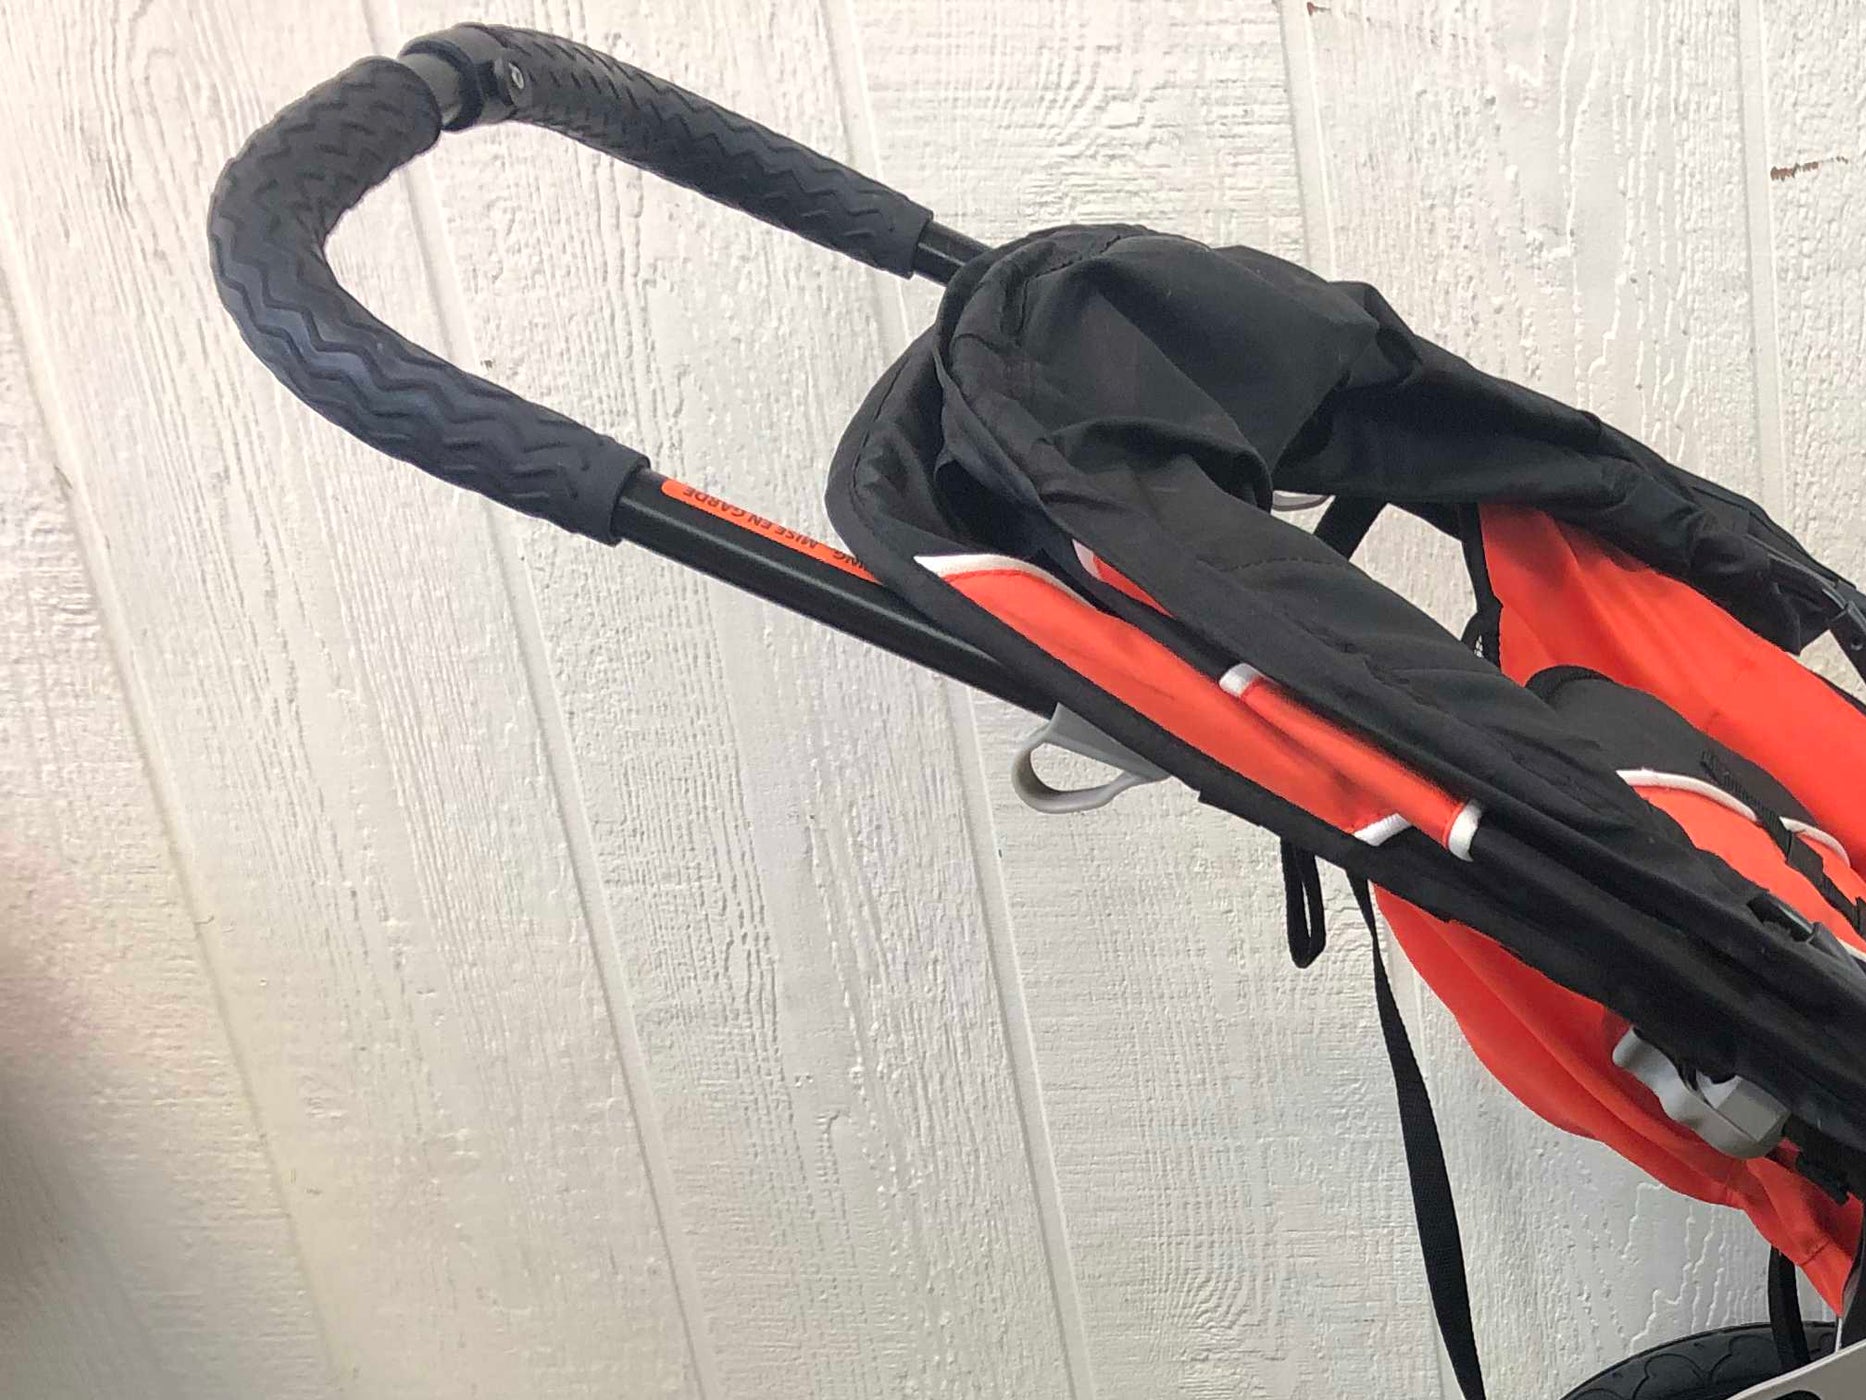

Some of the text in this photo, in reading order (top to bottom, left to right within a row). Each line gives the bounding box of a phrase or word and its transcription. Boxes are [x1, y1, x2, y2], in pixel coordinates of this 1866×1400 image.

[683, 485, 819, 549] MISE EN GARDE
